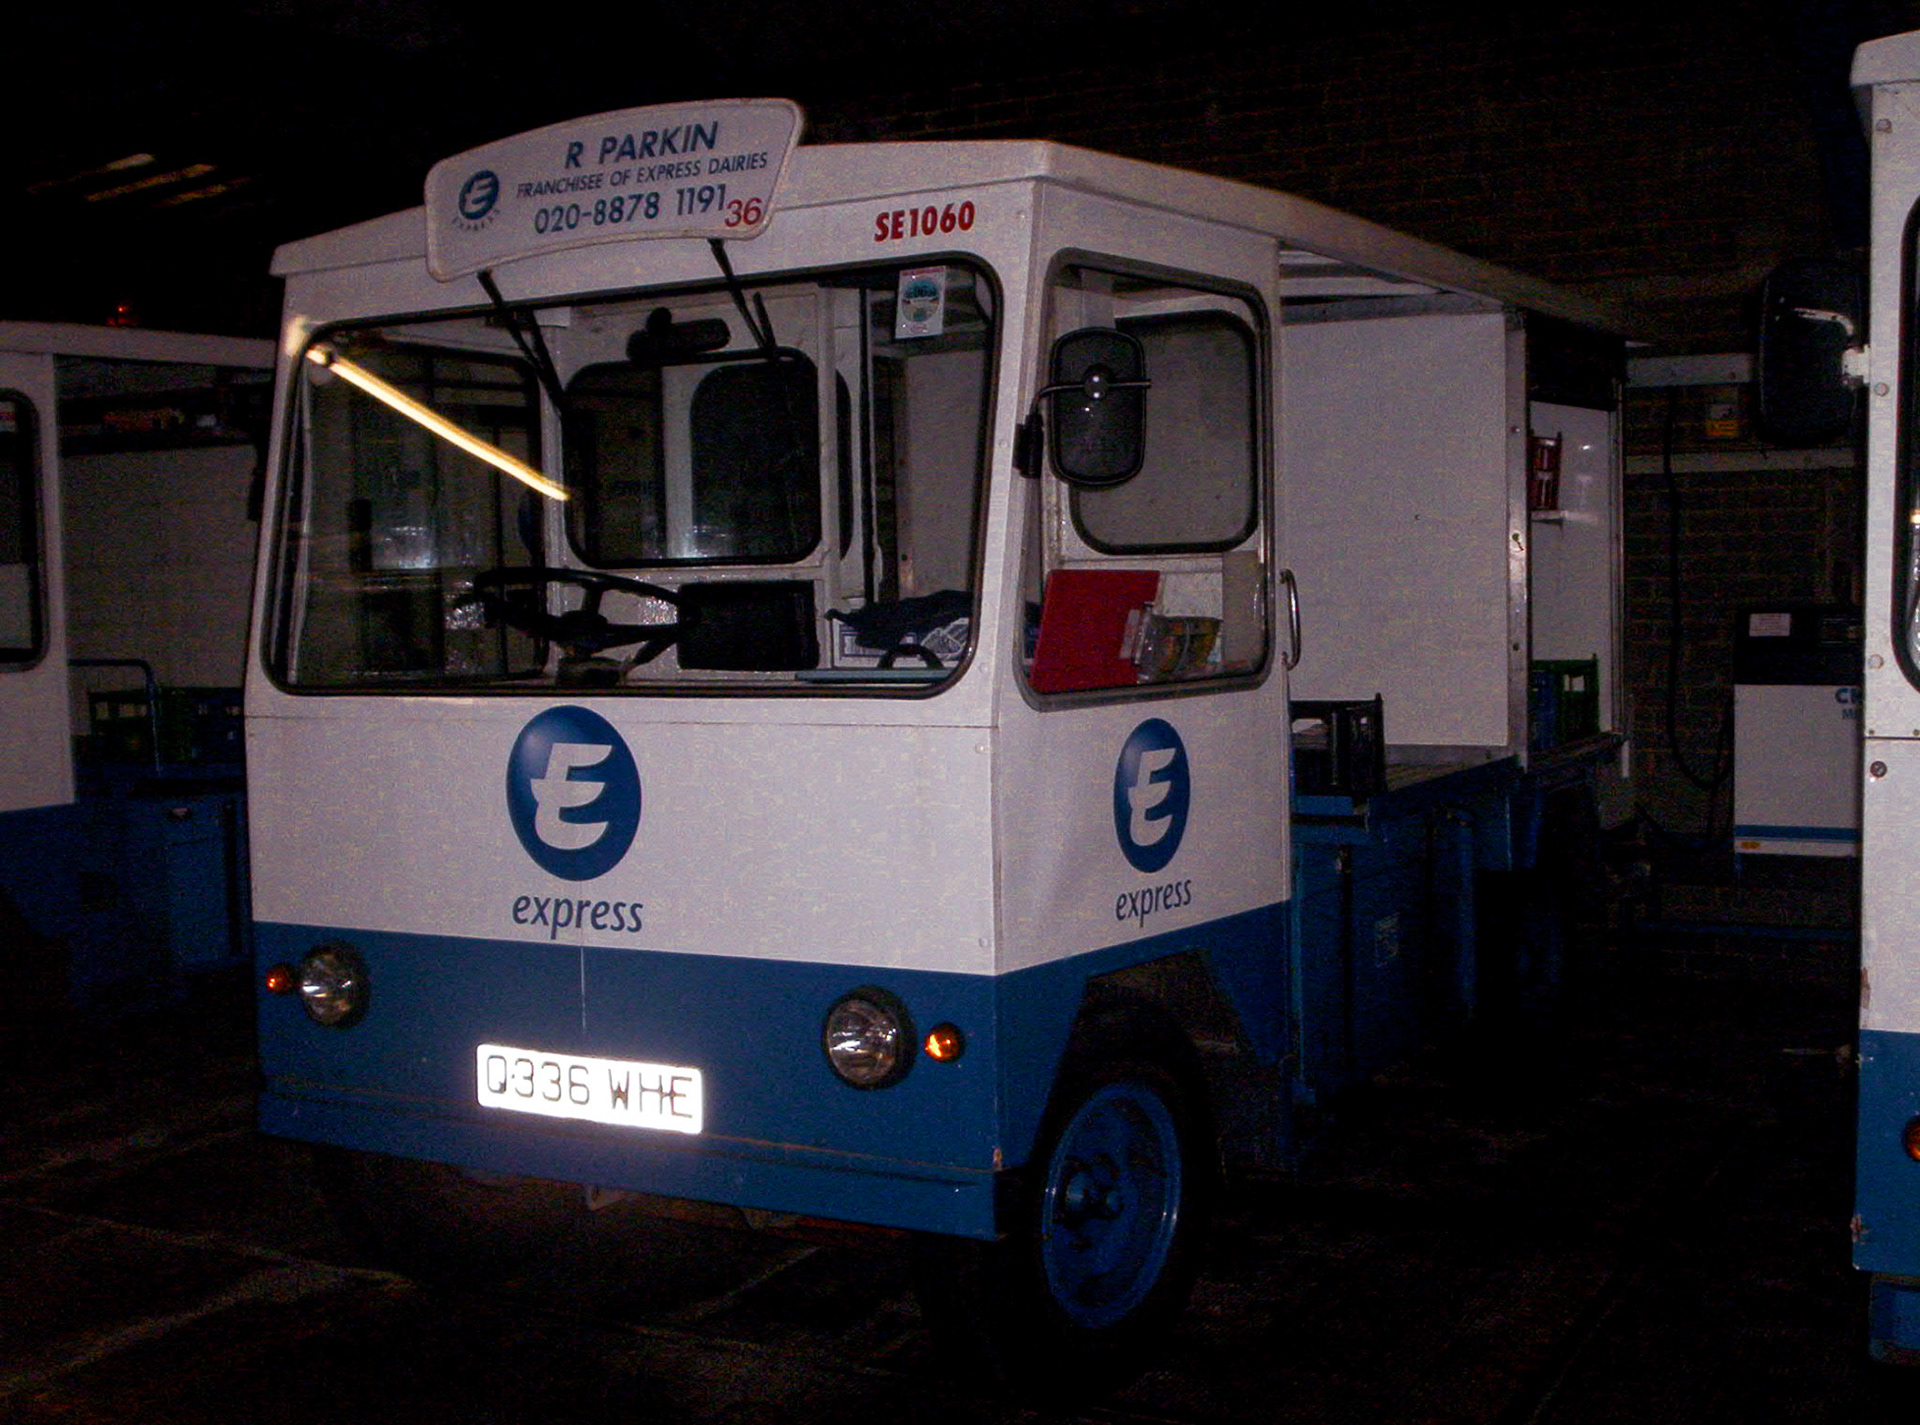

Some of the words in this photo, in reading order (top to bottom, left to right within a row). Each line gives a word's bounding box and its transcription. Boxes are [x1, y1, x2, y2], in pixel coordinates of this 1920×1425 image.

[565, 141, 584, 169] R
[598, 120, 719, 165] PARKIN
[516, 172, 604, 198] FRANCHISEE
[609, 168, 631, 187] OF
[636, 159, 701, 183] EXPRESS
[708, 151, 768, 175] DAIRIES
[534, 191, 660, 234] 020-8878
[675, 183, 727, 216] 1191
[724, 197, 763, 228] 36
[874, 200, 975, 242] SE1060
[512, 895, 644, 940] express
[1115, 879, 1193, 928] express
[486, 1054, 591, 1106] Q336
[607, 1067, 693, 1119] WHE
